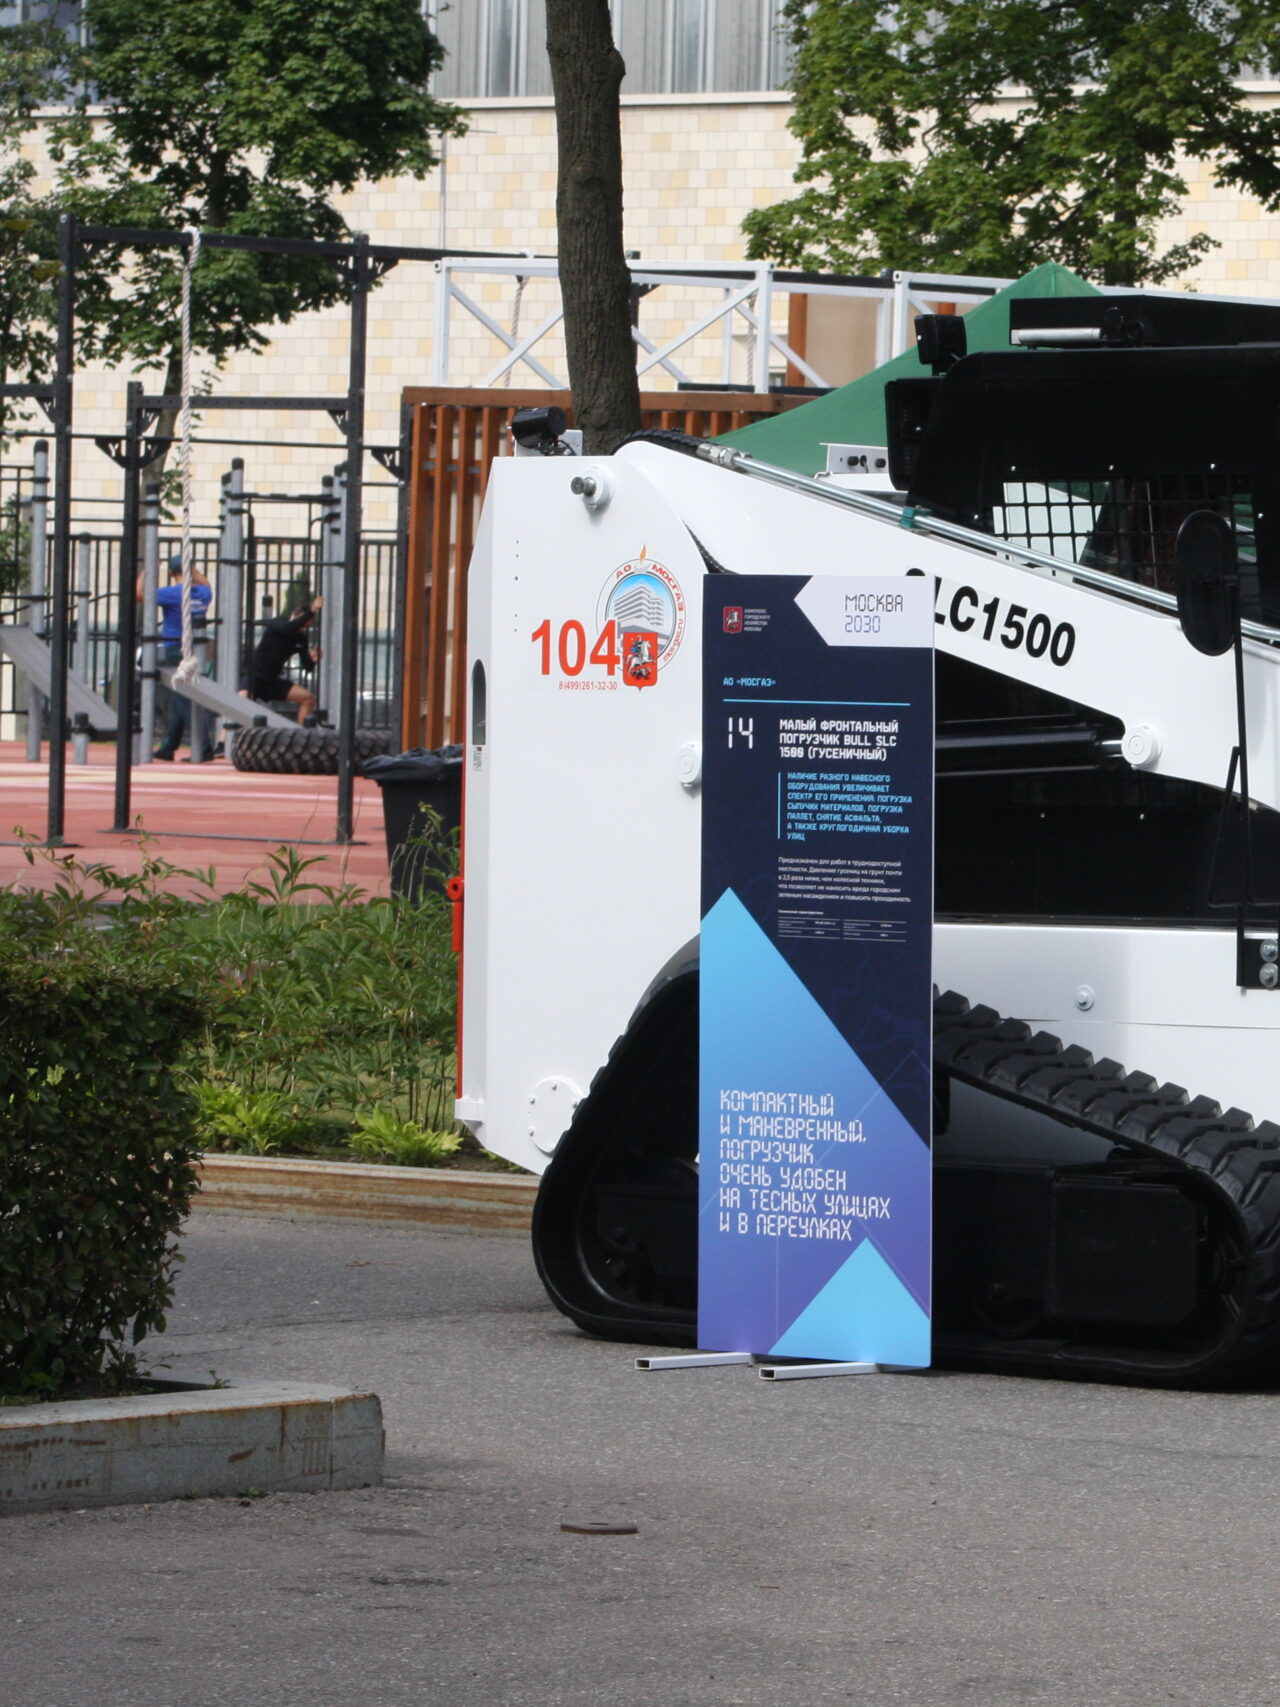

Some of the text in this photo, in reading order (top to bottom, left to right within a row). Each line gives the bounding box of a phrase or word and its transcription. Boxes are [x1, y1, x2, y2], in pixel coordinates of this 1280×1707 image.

[615, 563, 685, 612] АО МОСГАЗ
[845, 594, 904, 613] МОСКВА
[845, 615, 881, 633] 2030
[906, 567, 1076, 667] LC1500
[531, 619, 621, 677] 104
[723, 677, 776, 687] АО «МОСГАЗ»
[728, 717, 753, 749] 14
[779, 718, 899, 733] МАЛЫЙ ФРОНТАЛЬНЫЙ
[779, 732, 897, 747] ПОГРУЗЧИК BULL SLC
[807, 746, 887, 762] (ГУСЕНИЧНЫЙ)
[787, 772, 891, 782] НАЛИЧИЕ РАЗНОГО НАВЕСНОГО
[787, 782, 890, 792] ОБОРУДОВАНИЯ УВЕЛИЧИВАЕТ
[787, 792, 813, 800] СПЕКТР
[877, 795, 913, 804] ПОГРУЗКА
[787, 802, 903, 813] СЫПУЧИХ МАТЕРИАЛОВ, ПОГРУЗКА
[787, 812, 882, 823] ПАЛЛЕТ, СНЯТИЕ АСФАЛЬТА,
[787, 822, 910, 834] А ТАКЖЕ КРУГЛОГОДИЧНАЯ УБОРКА
[787, 832, 805, 841] УЛИЦ
[720, 1089, 834, 1117] КОМПАКТНЫЙ
[720, 1115, 867, 1143] И МАНЕВРЕННЫЙ,
[720, 1138, 814, 1164] ПОГРУЗЧИК
[720, 1163, 847, 1191] ОЧЕНЬ УДОБЕН
[720, 1188, 891, 1220] НА ТЕСНЫХ УЛИЦАХ
[720, 1212, 853, 1241] И В ПЕРЕУЛКАХ
